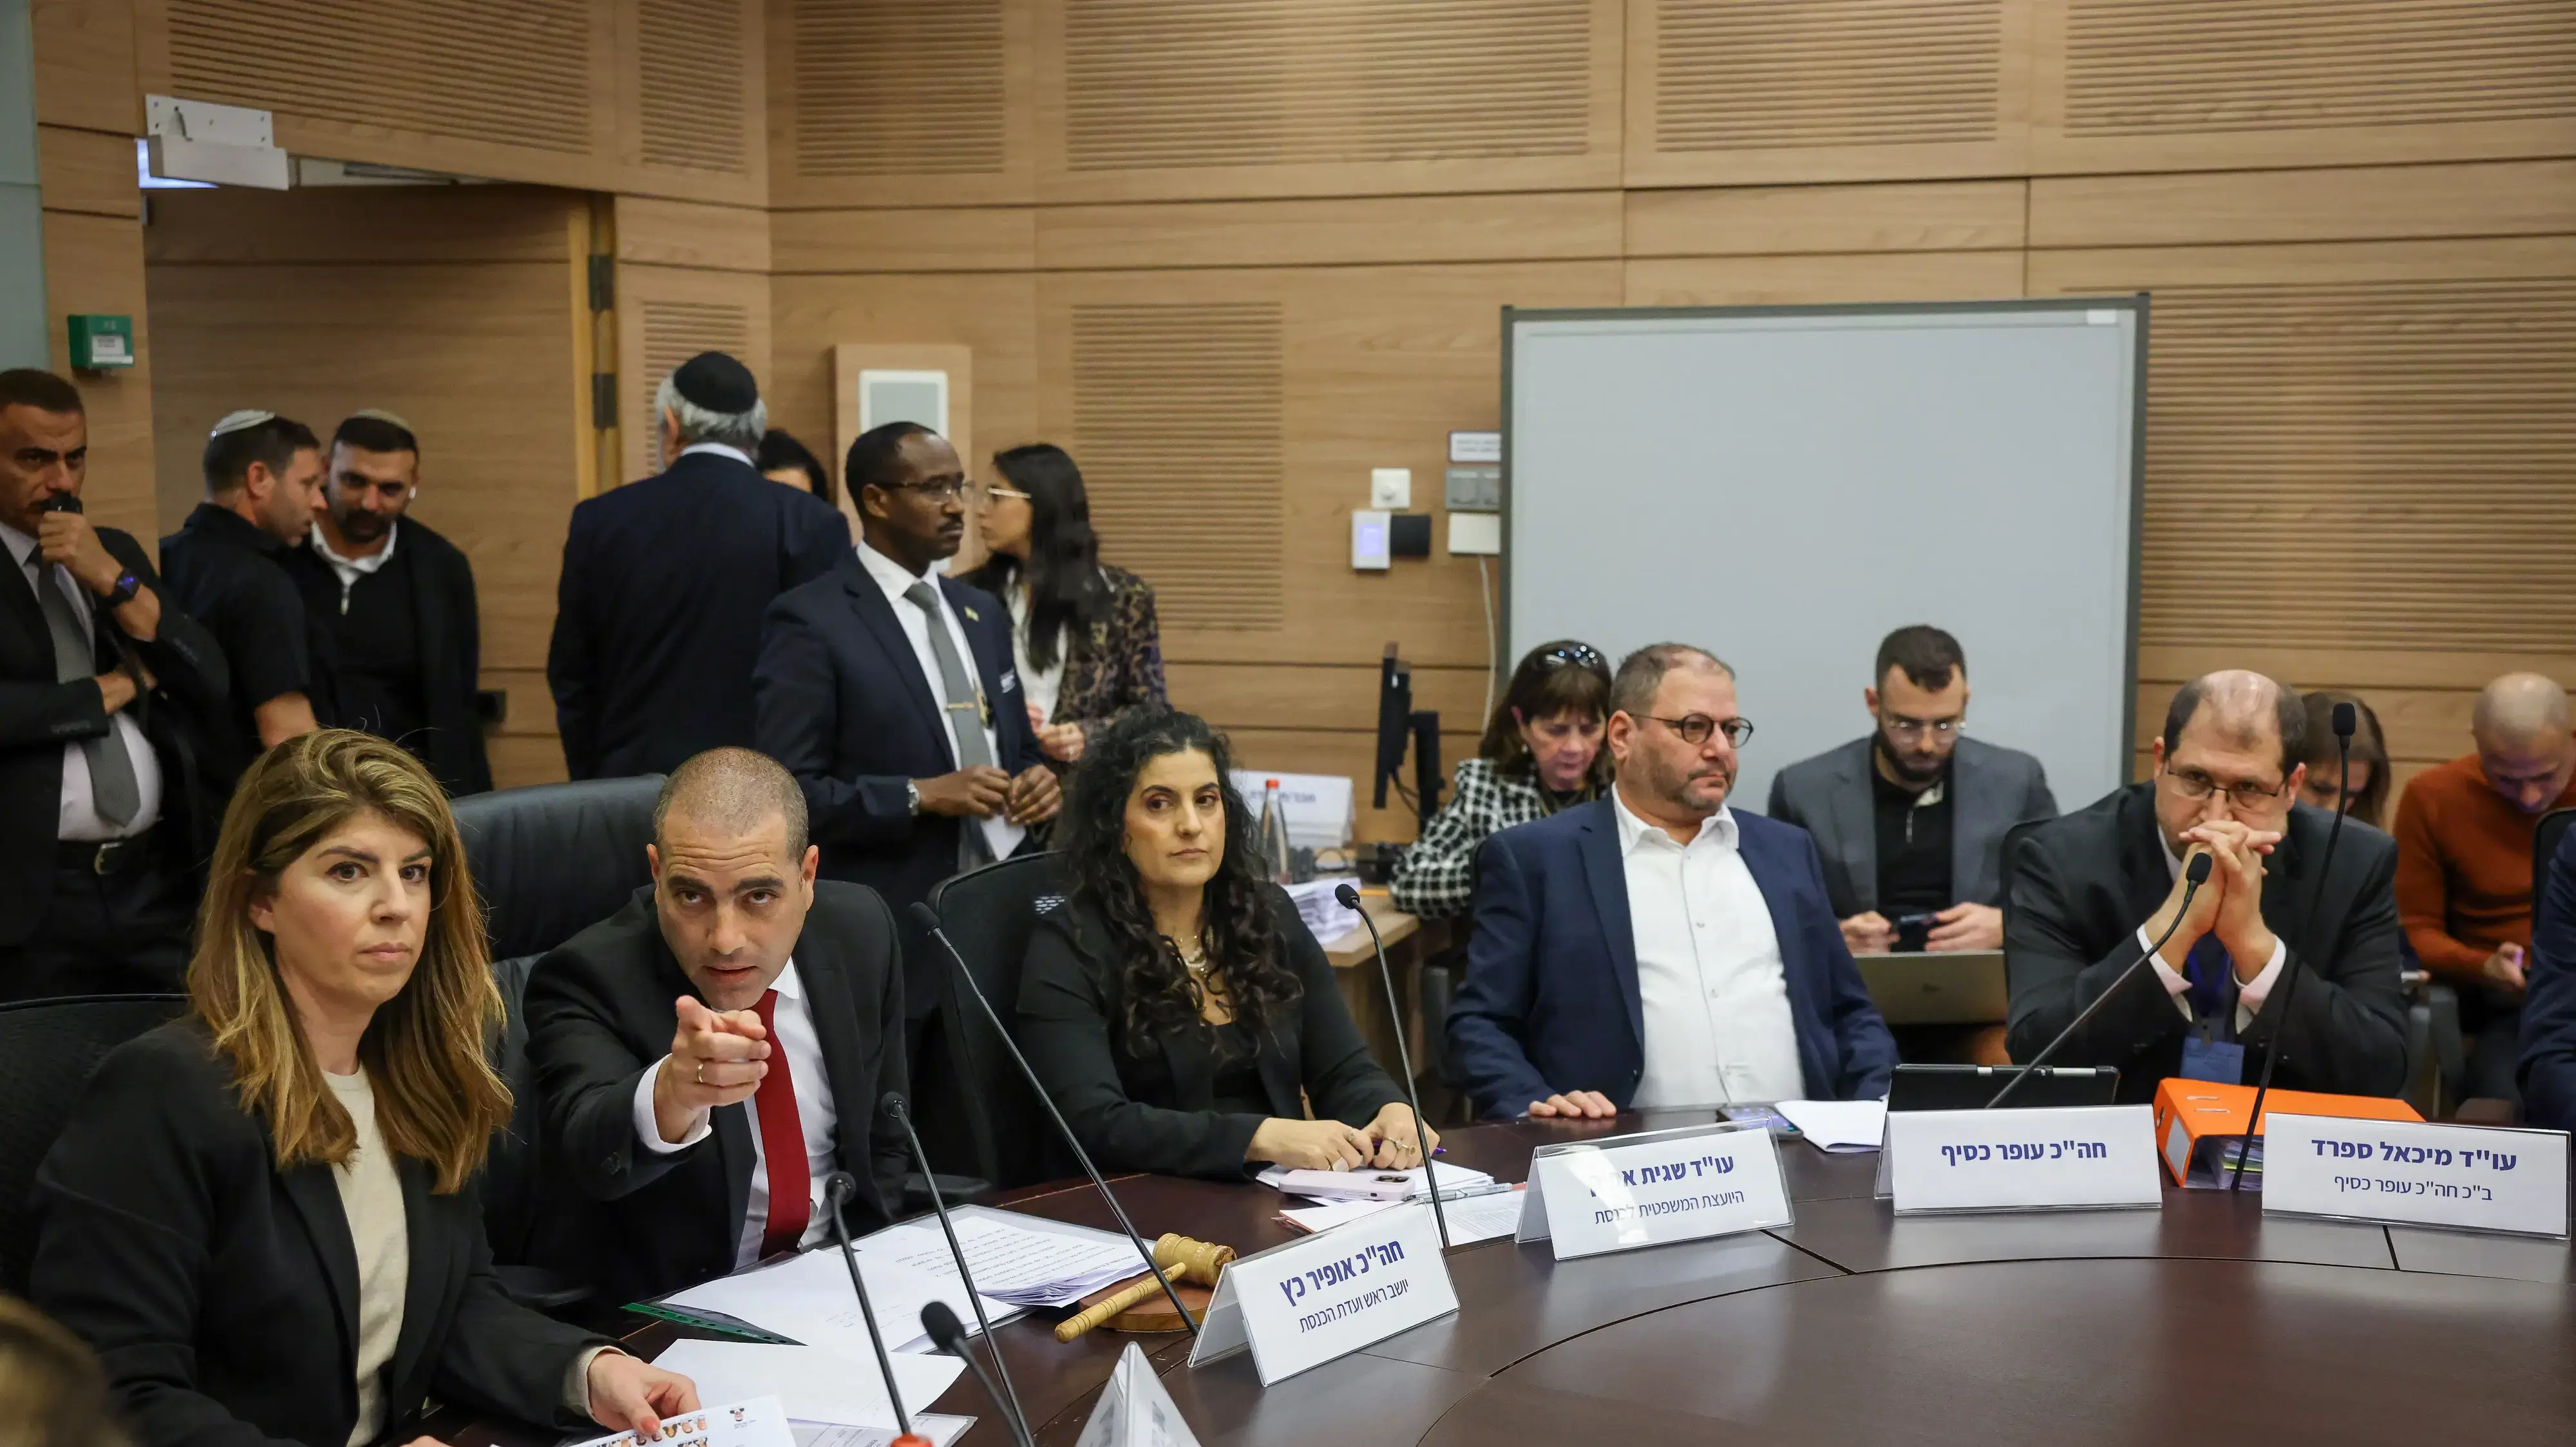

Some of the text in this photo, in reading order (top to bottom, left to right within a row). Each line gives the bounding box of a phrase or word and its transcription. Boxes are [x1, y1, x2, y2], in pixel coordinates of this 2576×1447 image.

[1941, 1140, 2107, 1166] חה"כ עופר כסיף
[2311, 1139, 2517, 1171] עו"ד מיכאל ספרד
[1641, 1162, 1687, 1185] שגית
[1690, 1156, 1734, 1177] עו"ד
[1702, 1190, 1745, 1208] היועצת
[2334, 1175, 2493, 1201] ב"כ חה"כ עופר כסיף
[1638, 1196, 1700, 1218] המשפטית
[1280, 1240, 1405, 1307] חה"כ אופיר כץ
[1300, 1279, 1409, 1333] יושב ראש ועדת הכנסת
